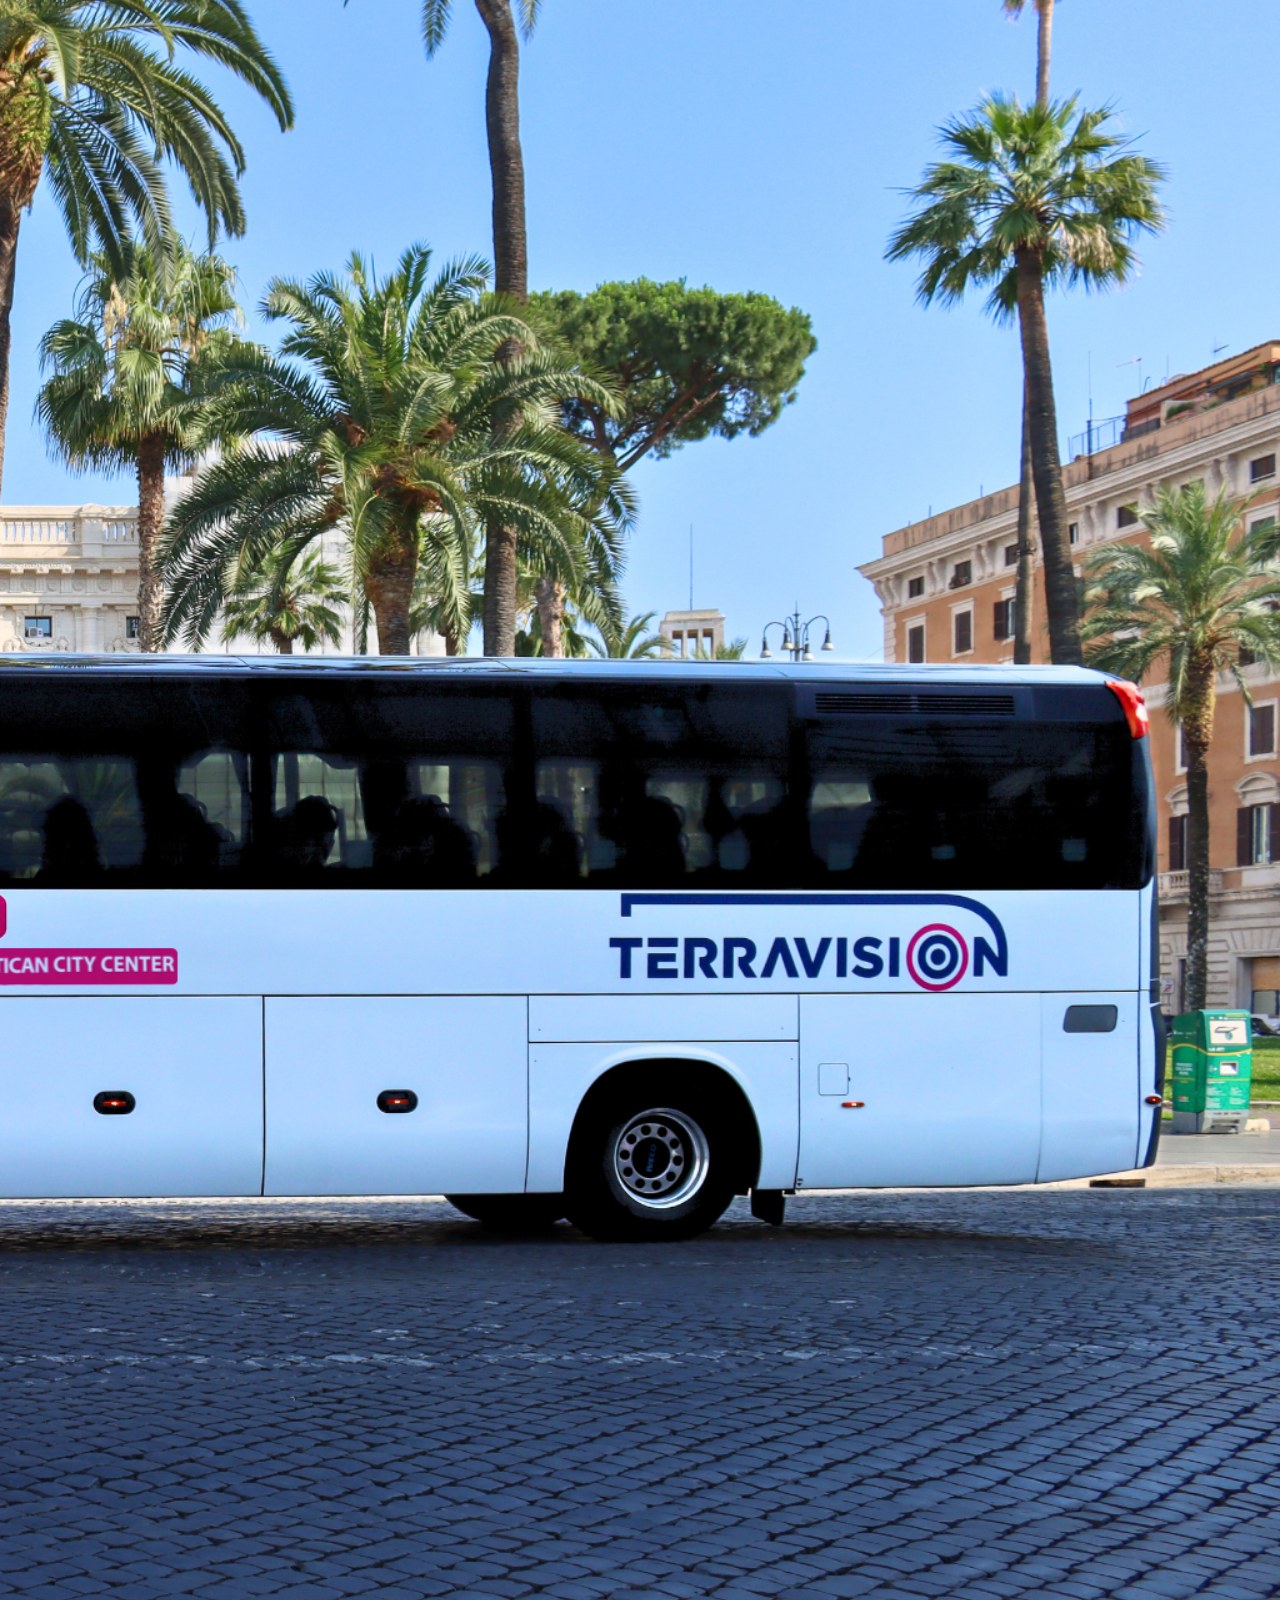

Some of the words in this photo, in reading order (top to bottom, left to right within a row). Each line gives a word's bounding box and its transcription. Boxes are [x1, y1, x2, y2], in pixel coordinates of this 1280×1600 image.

[53, 956, 96, 973] CITY
[100, 955, 175, 973] CENTER
[609, 923, 1009, 992] TERRAVISION
